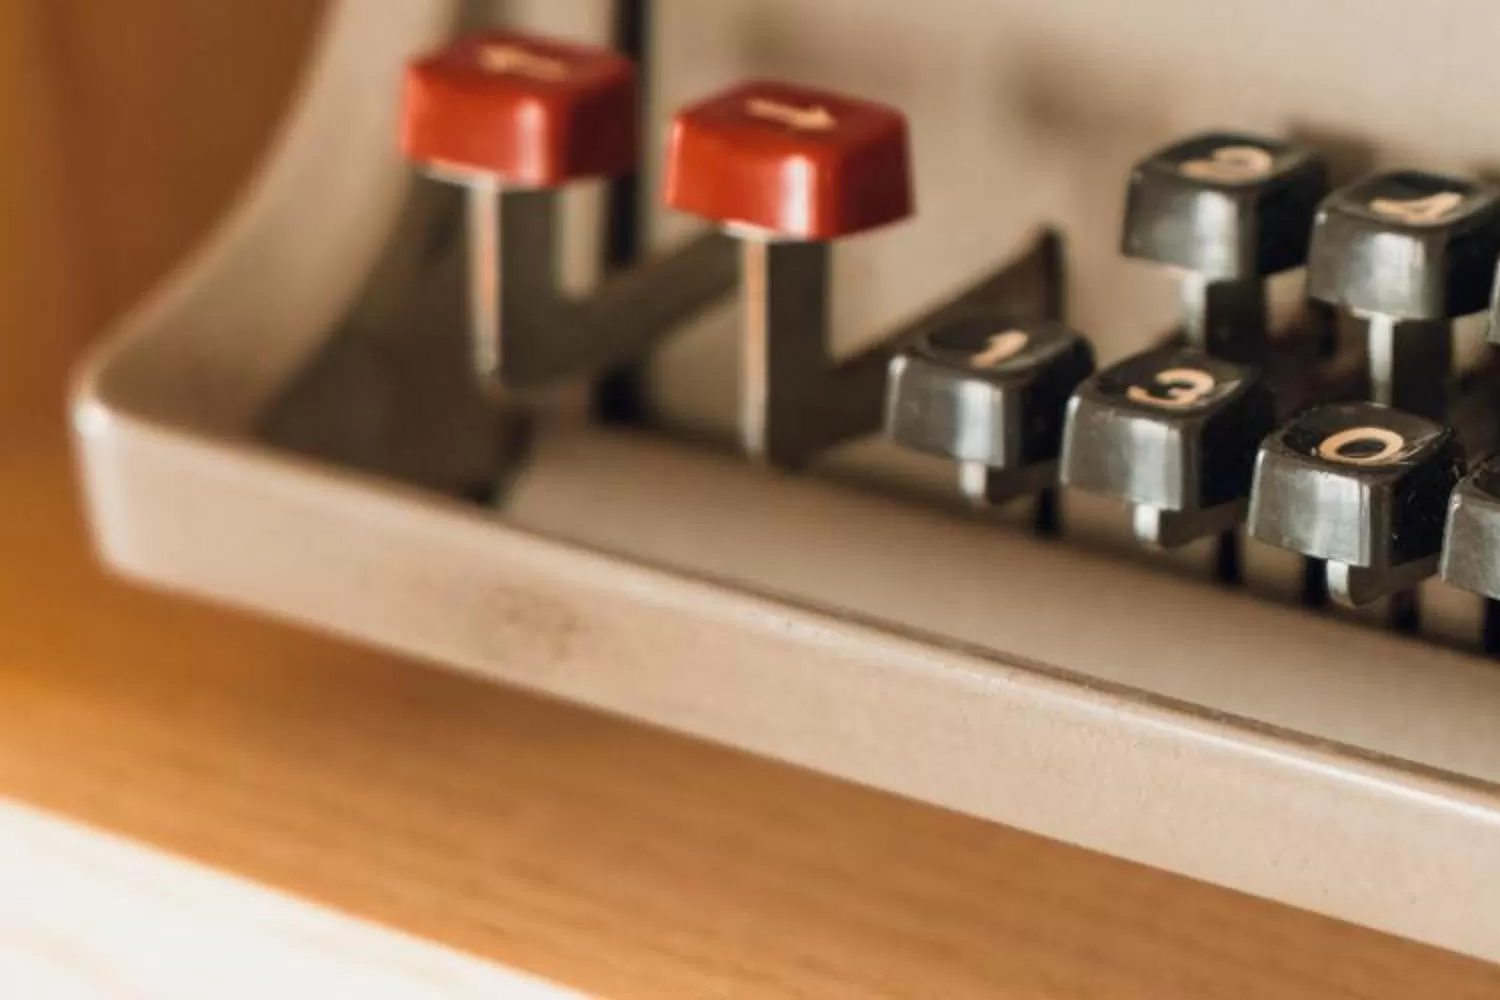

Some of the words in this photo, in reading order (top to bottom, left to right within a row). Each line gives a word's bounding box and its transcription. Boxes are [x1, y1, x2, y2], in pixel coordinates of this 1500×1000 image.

[1177, 145, 1273, 184] 2
[1369, 191, 1463, 226] 4
[970, 330, 1029, 368] 1
[1126, 368, 1215, 410] 3
[1319, 427, 1405, 465] 0
